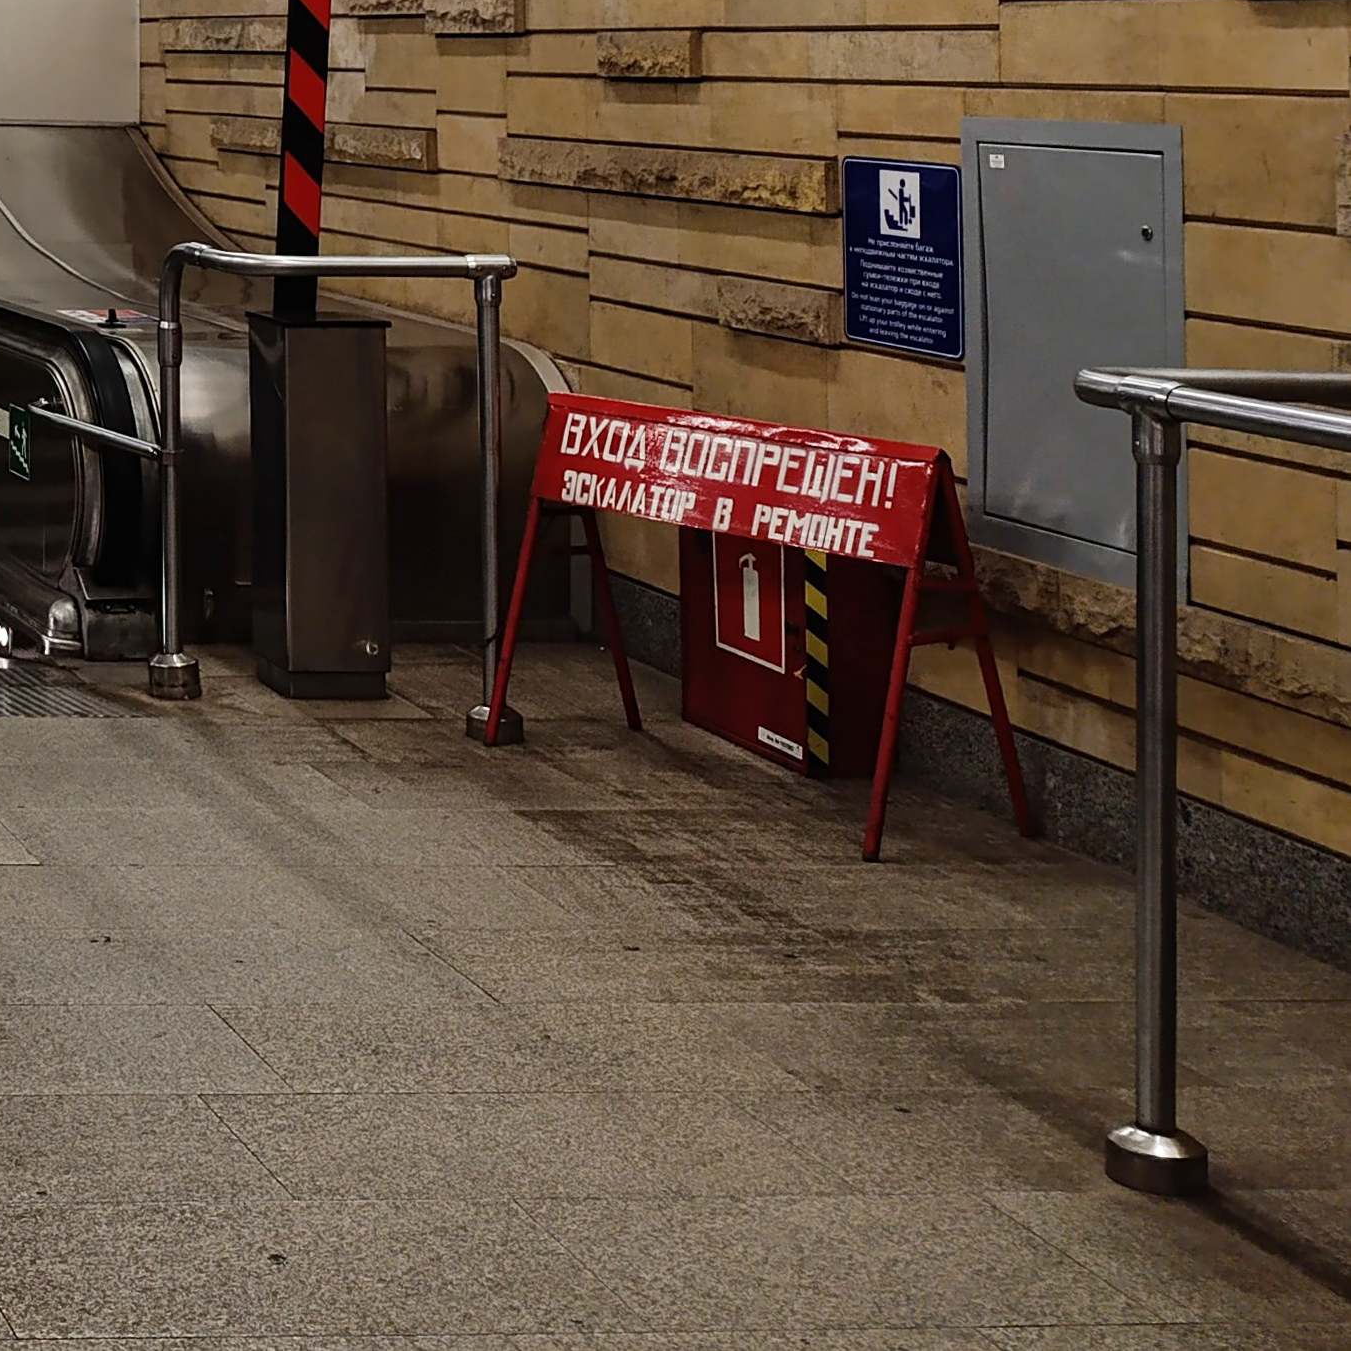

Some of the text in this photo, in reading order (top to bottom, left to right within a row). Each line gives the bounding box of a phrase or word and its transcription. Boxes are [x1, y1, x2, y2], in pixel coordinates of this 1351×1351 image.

[560, 412, 899, 510] ВХОД ВОСПРЕЩЕН!
[561, 469, 880, 558] ЭСКАЛАТОР В РЕМОНТЕ
